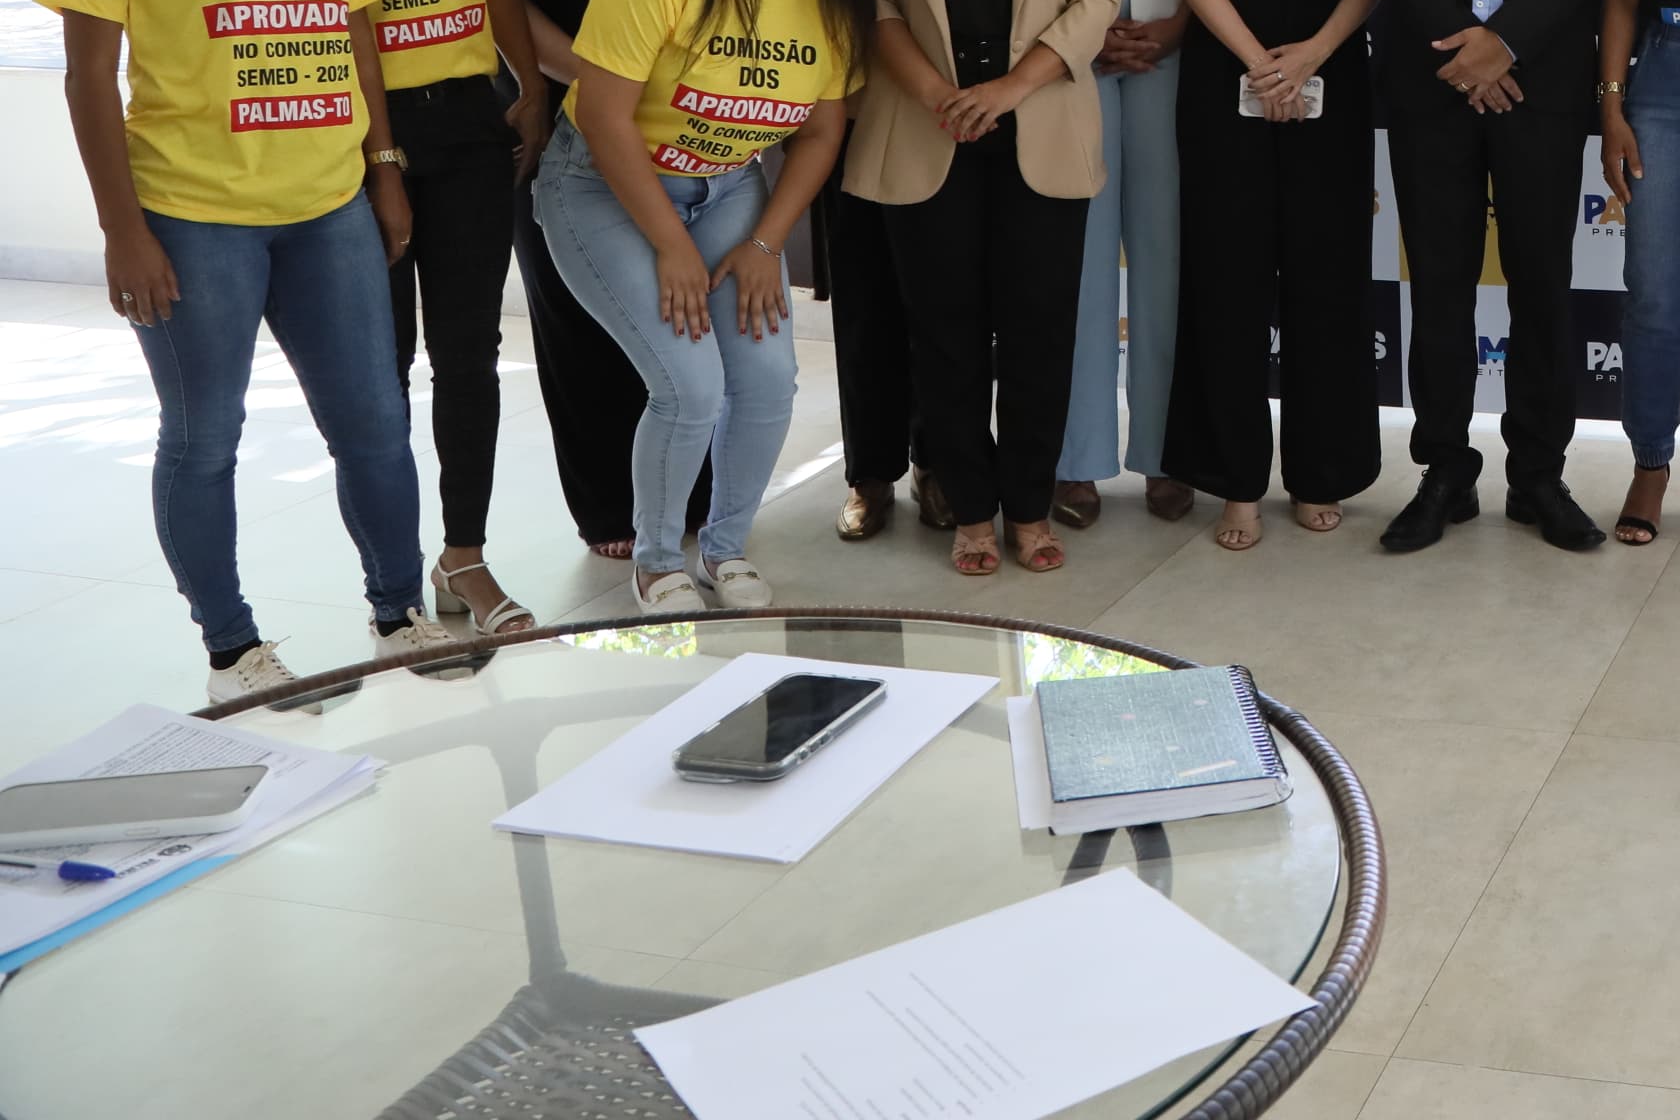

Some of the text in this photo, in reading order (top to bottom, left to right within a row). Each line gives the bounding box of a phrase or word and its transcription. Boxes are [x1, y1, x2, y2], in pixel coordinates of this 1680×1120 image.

[383, 7, 482, 45] PALMAS-TO
[232, 43, 258, 59] NO
[708, 35, 817, 65] COMISSÃO
[237, 67, 298, 87] SEMED
[316, 64, 349, 84] 2024
[739, 66, 780, 89] DOS
[238, 96, 351, 124] PALMAS-TO
[686, 117, 710, 134] NO
[676, 134, 733, 158] SEMED
